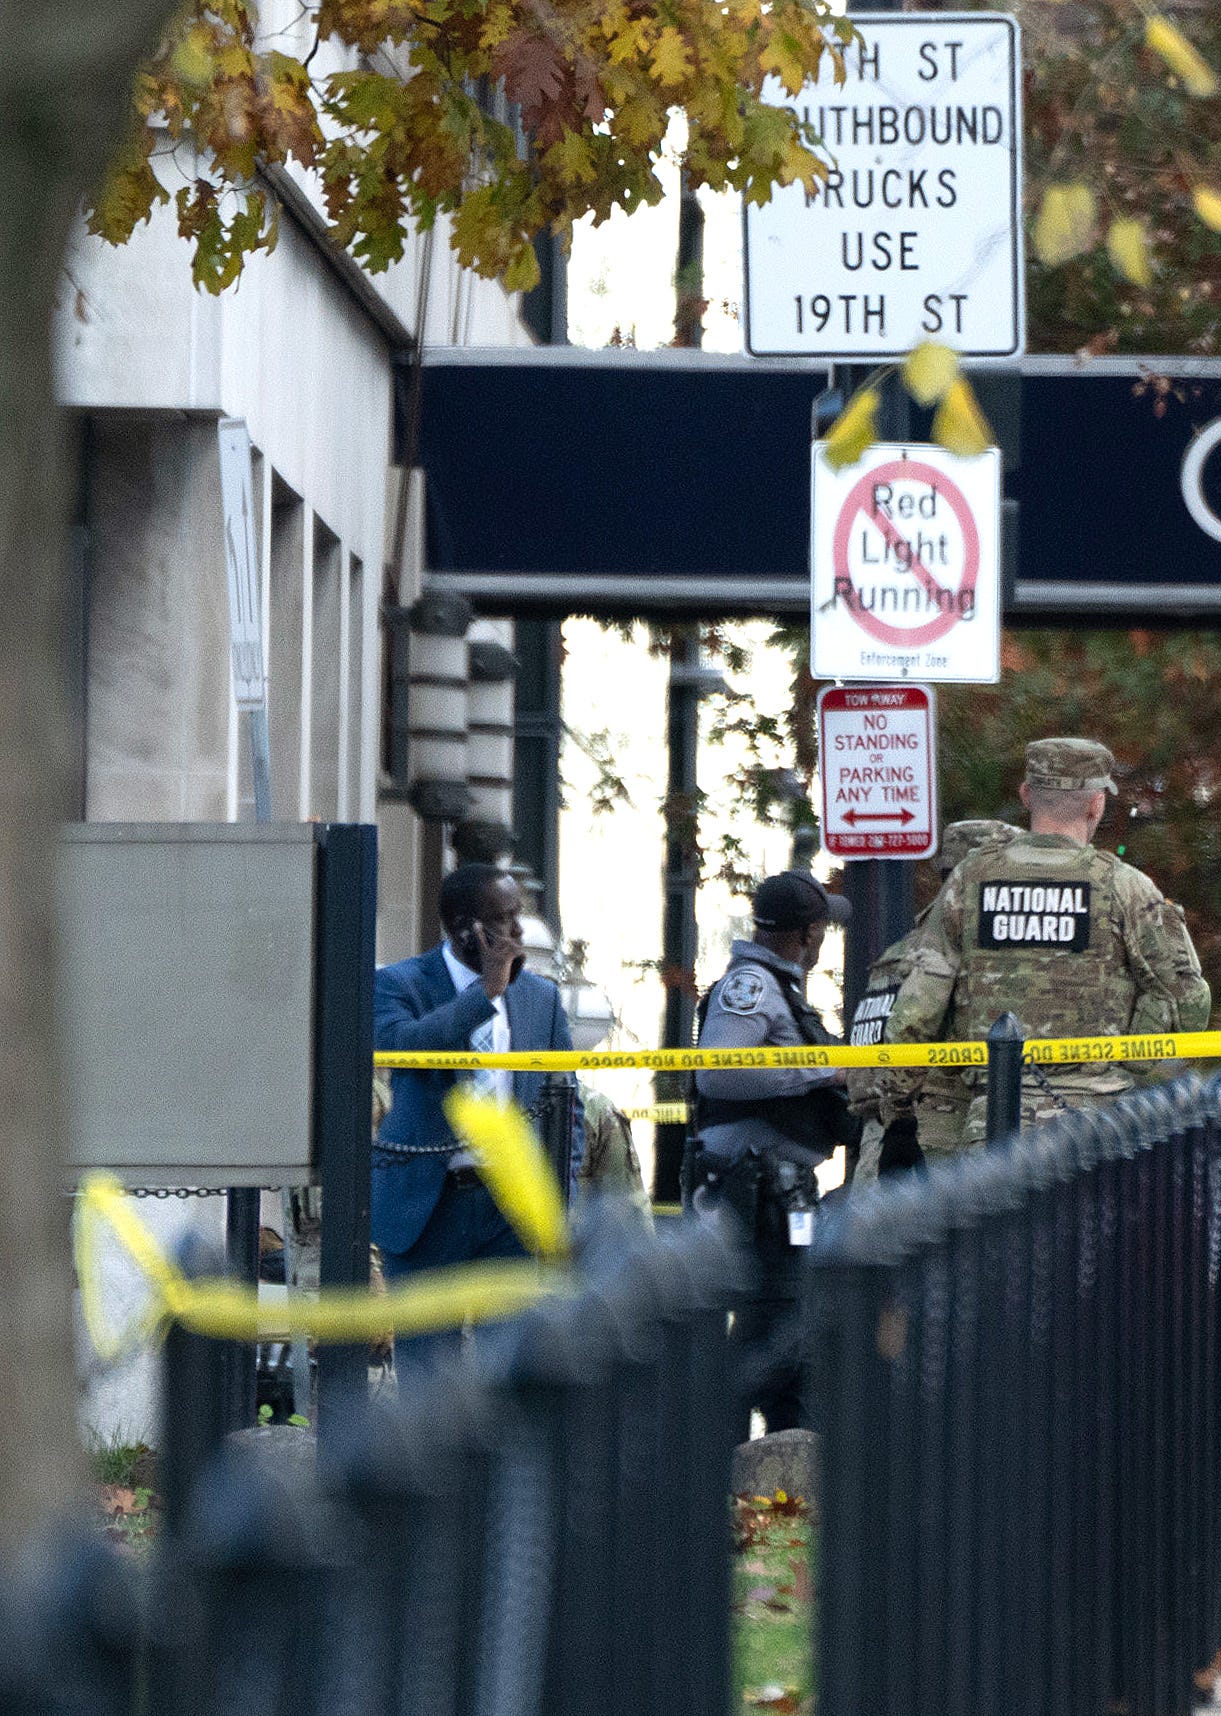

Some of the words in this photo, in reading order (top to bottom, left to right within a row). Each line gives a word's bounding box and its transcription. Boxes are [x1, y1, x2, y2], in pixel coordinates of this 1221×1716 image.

[918, 42, 962, 80] ST
[790, 106, 1002, 145] UTHBOUND
[842, 232, 919, 271] USE
[793, 294, 885, 334] 19TH
[922, 294, 968, 334] ST
[872, 483, 937, 520] Red
[862, 531, 948, 574] Light
[834, 576, 976, 621] Running
[863, 715, 888, 731] NO
[835, 734, 919, 751] STANDING
[869, 753, 884, 763] OR
[839, 766, 914, 784] PARKING
[835, 787, 873, 803] ANY
[882, 786, 920, 803] TIME
[983, 887, 1088, 914] NATIONAL
[992, 916, 1075, 942] GUARD
